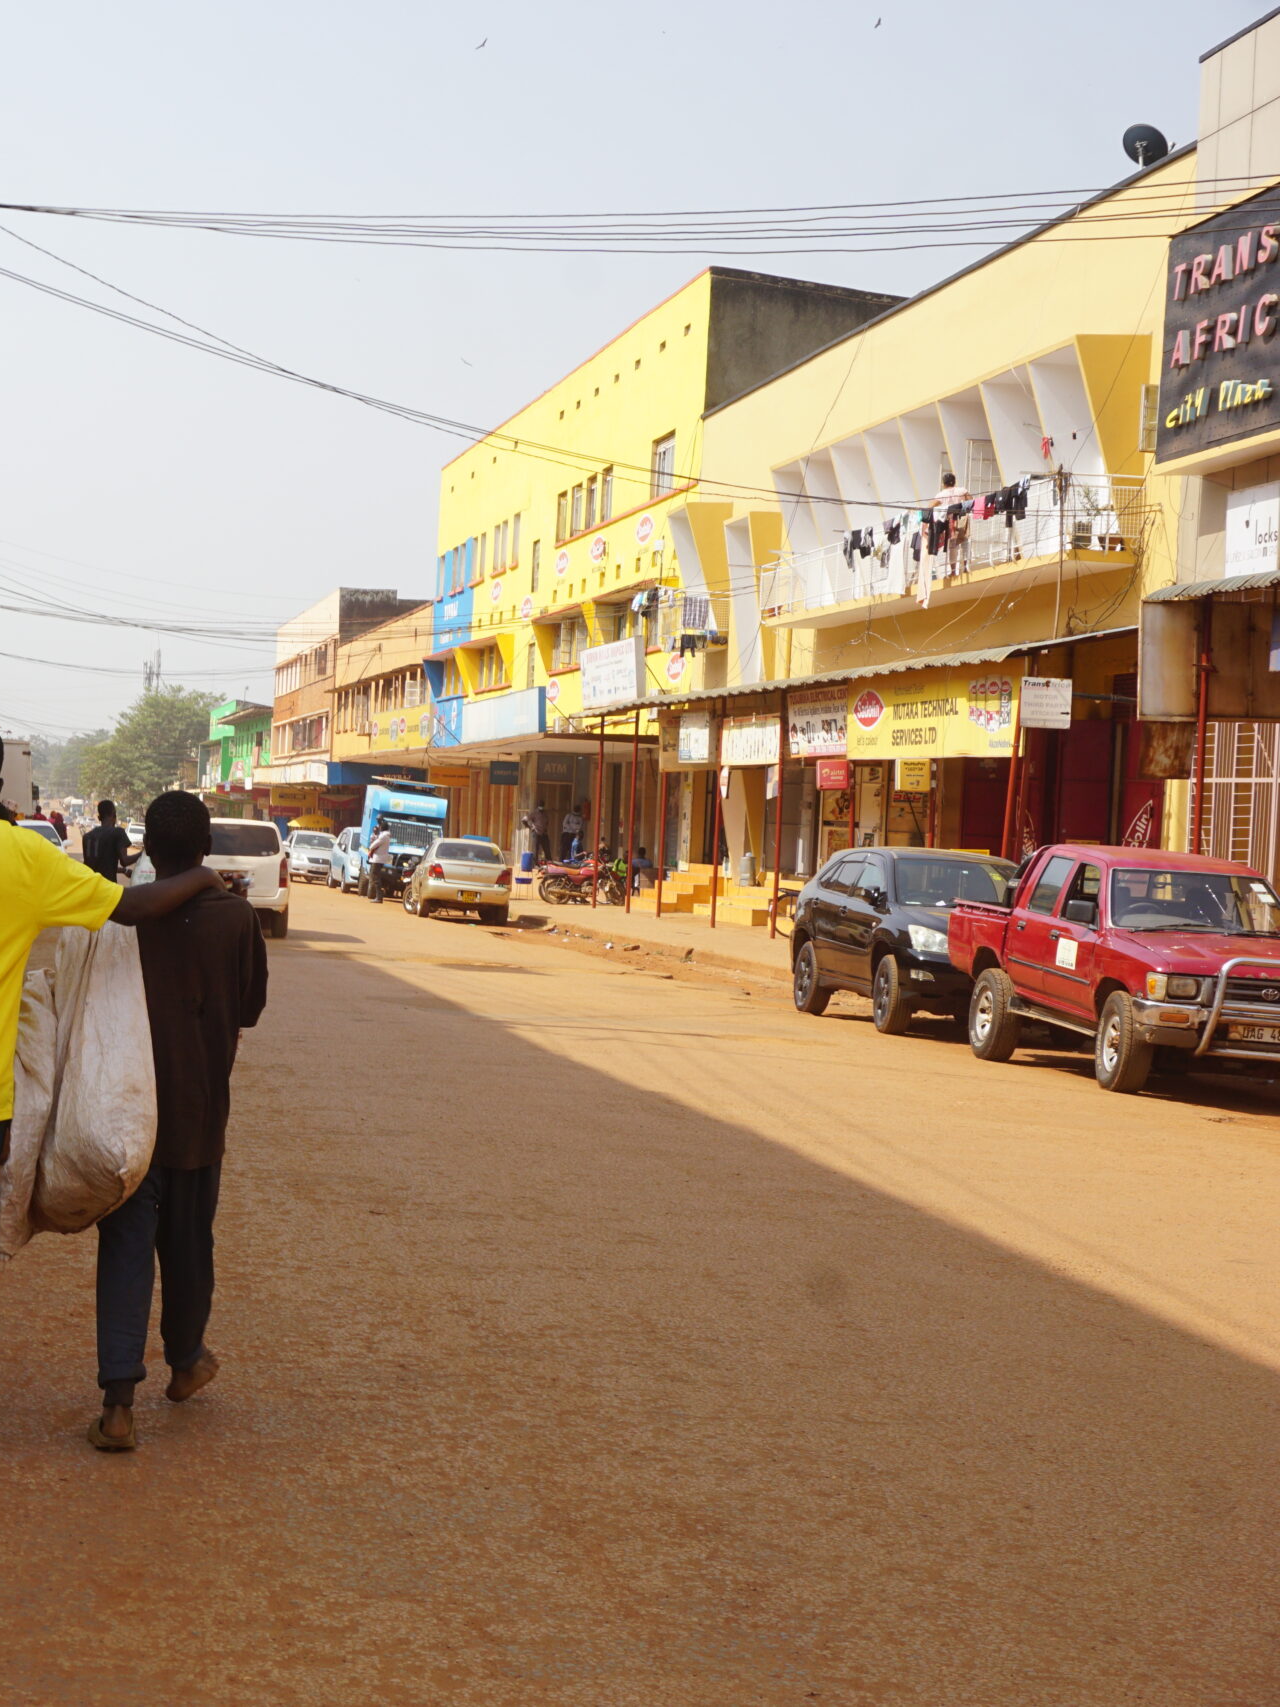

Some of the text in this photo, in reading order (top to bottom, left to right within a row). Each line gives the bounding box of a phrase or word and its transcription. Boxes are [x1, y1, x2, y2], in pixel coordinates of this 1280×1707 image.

[1173, 223, 1280, 301] TRANS
[1255, 516, 1278, 545] locks
[856, 699, 880, 719] Sadolin
[893, 698, 959, 721] MUTAKA TECHNICAL
[892, 727, 937, 746] SERVICES LTD
[543, 763, 567, 774] ATM
[1242, 1026, 1265, 1040] UAG
